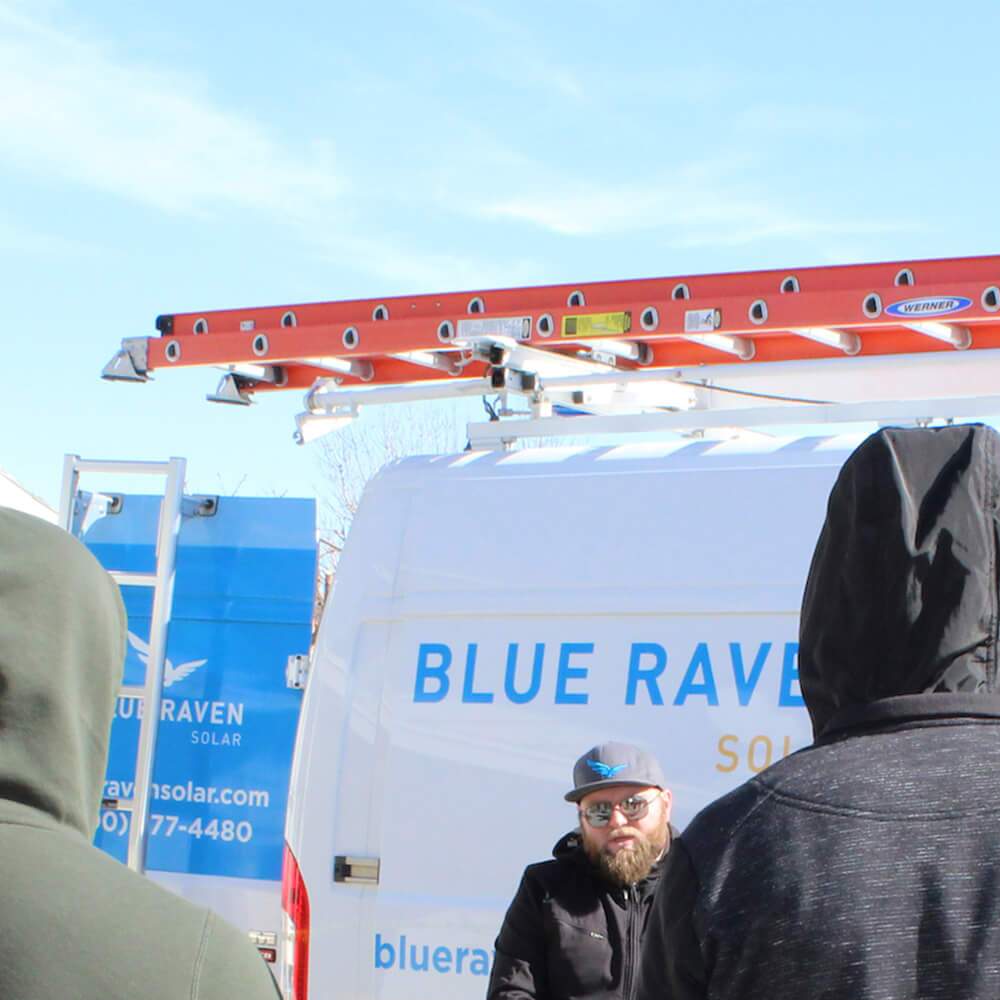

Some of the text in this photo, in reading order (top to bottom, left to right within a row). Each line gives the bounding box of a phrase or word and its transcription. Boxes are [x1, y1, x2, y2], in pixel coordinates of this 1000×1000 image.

[904, 301, 954, 312] WERNER
[412, 642, 595, 704] BLUE
[113, 697, 244, 726] UE RAVEN
[191, 730, 241, 747] SOLAR
[374, 933, 496, 976] bluera
